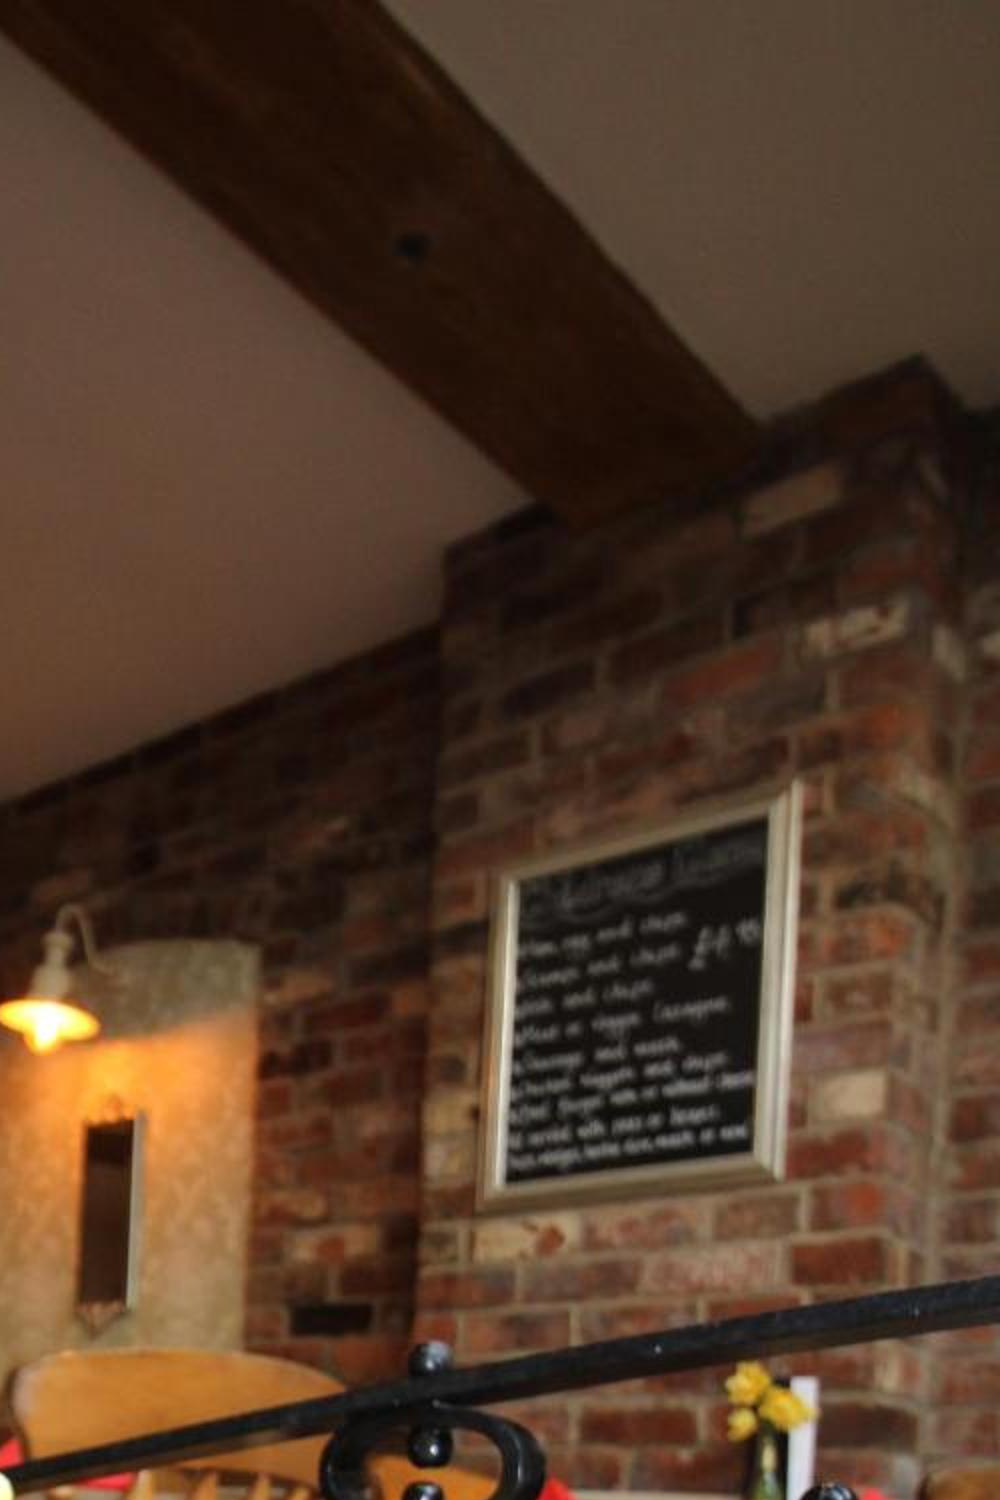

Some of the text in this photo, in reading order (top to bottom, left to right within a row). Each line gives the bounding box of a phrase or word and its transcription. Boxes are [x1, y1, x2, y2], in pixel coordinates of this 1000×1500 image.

[596, 918, 632, 943] and
[587, 954, 623, 976] and
[562, 985, 597, 1009] and
[603, 977, 655, 1003] chips
[594, 1044, 629, 1061] and
[643, 1058, 675, 1078] and
